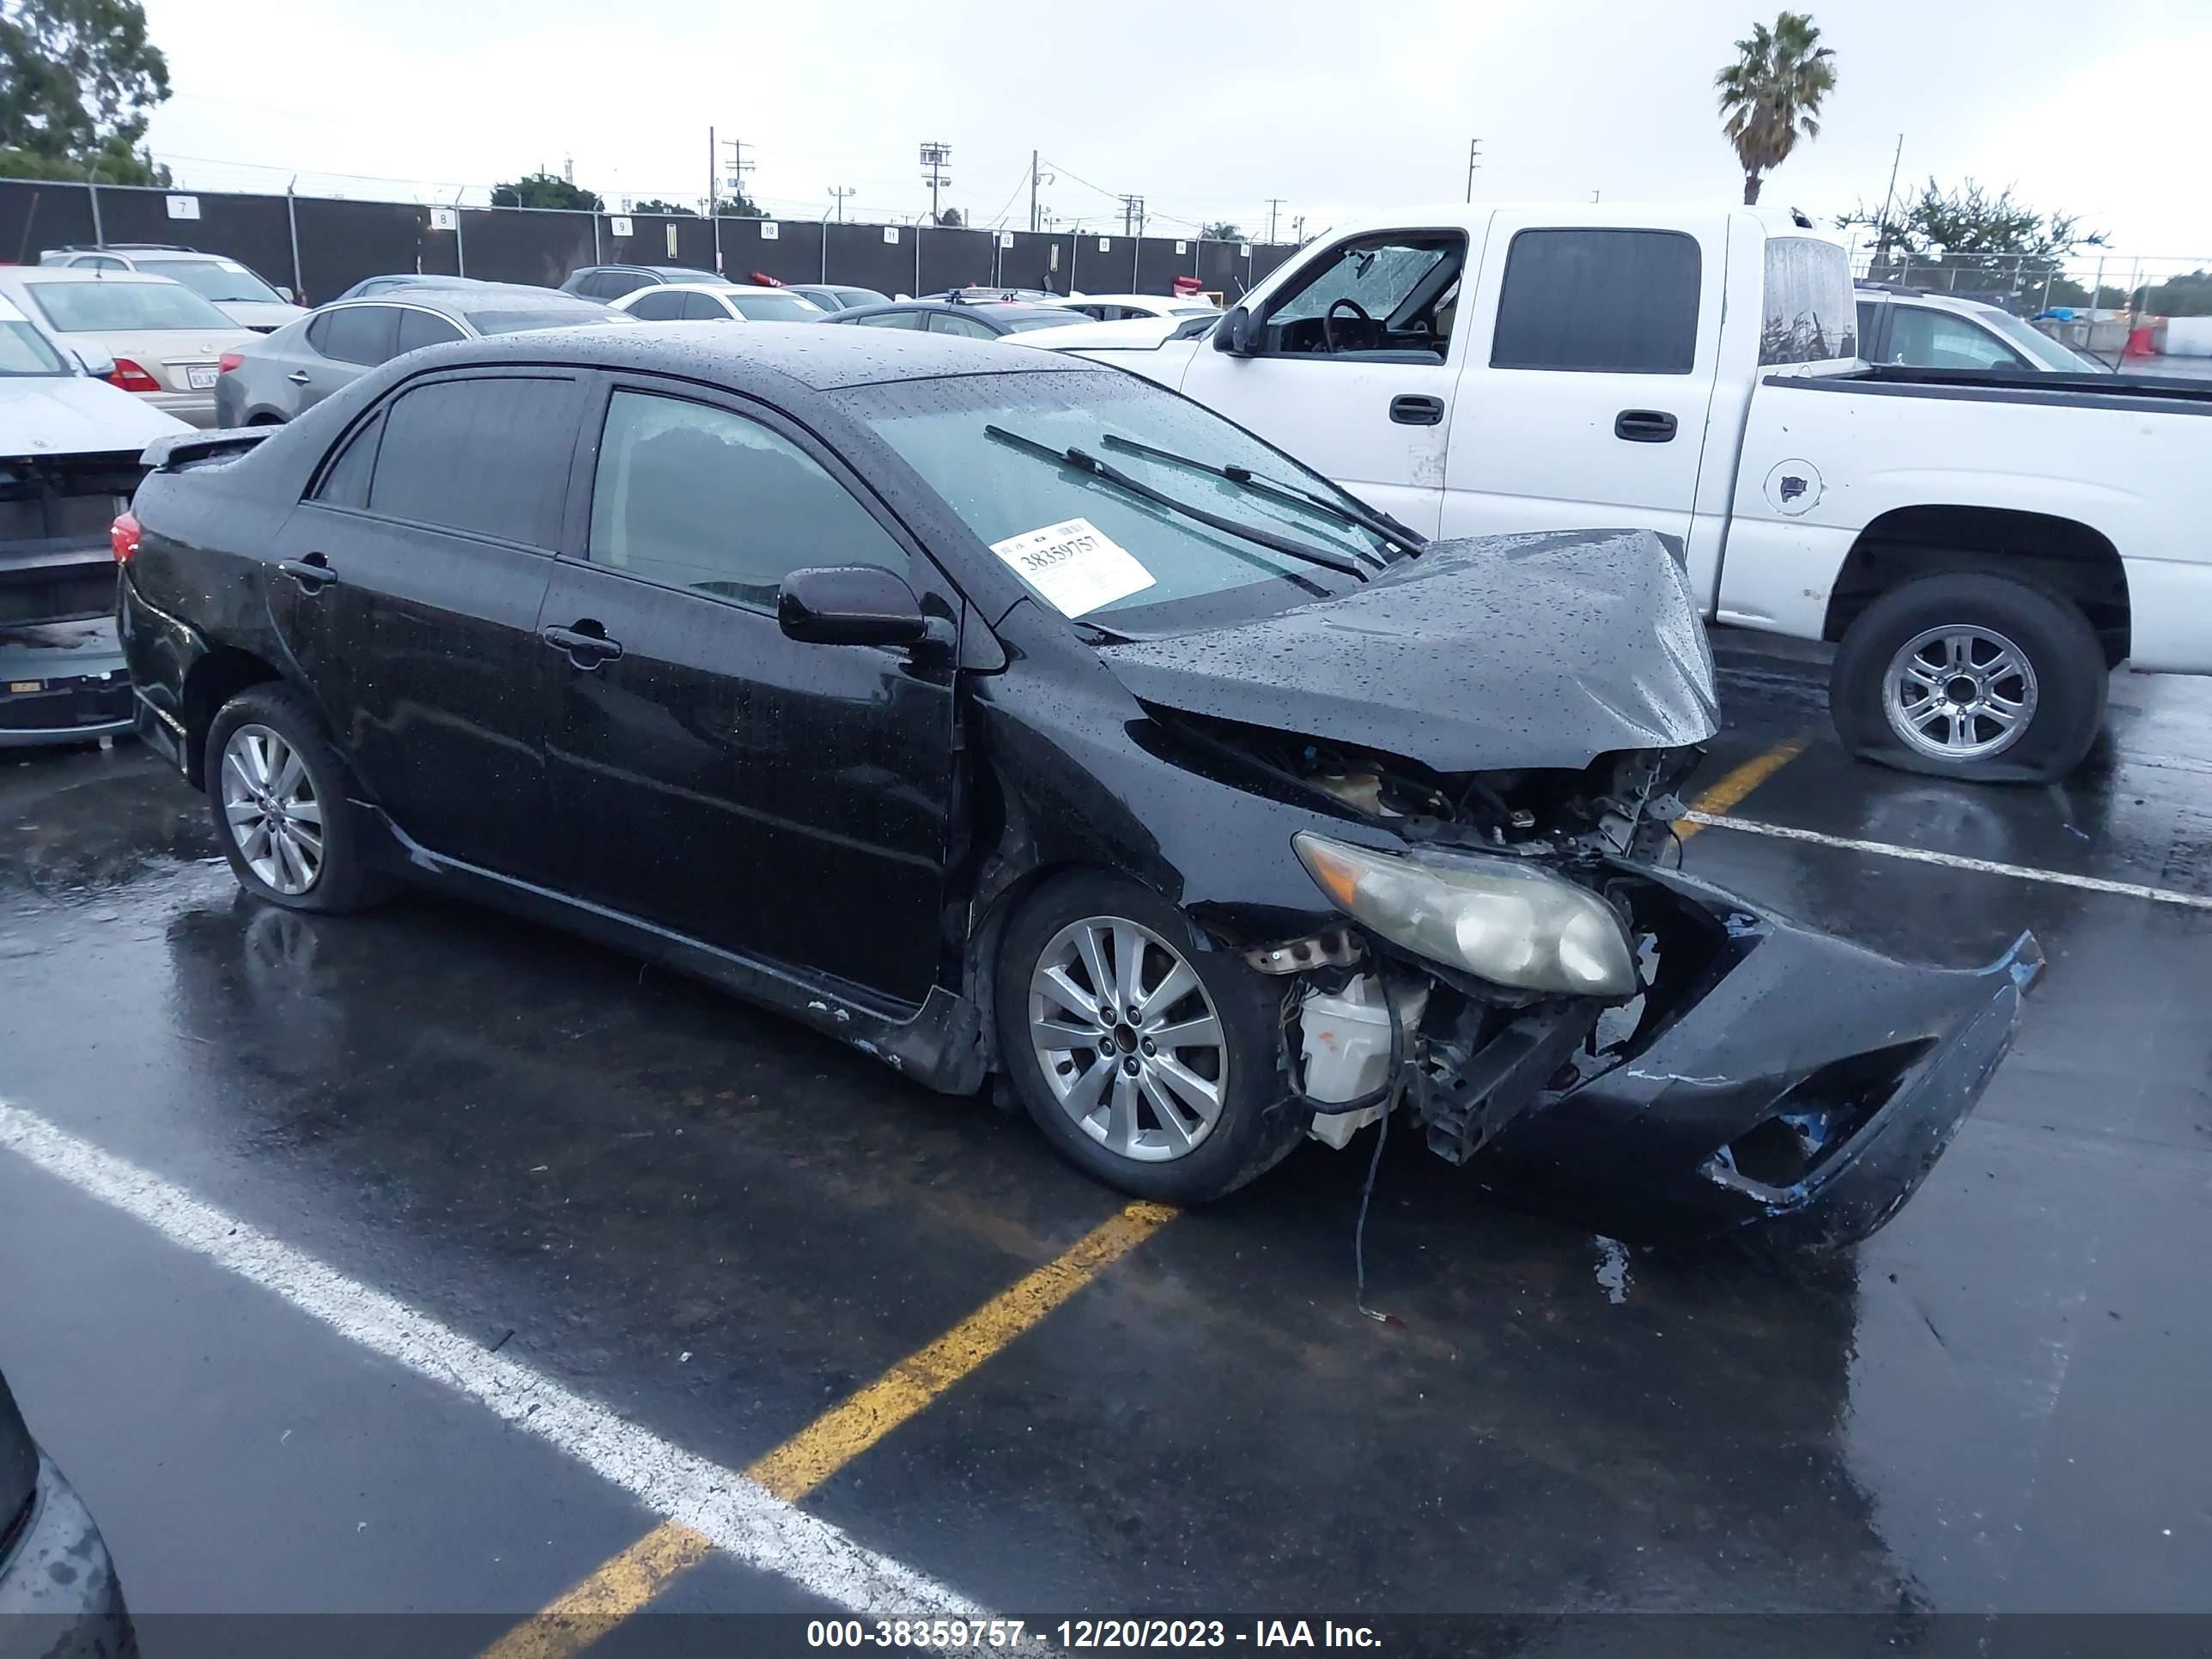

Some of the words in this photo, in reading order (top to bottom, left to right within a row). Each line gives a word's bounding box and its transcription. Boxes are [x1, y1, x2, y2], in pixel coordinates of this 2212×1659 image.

[178, 201, 186, 213] 7
[440, 214, 447, 225] 8
[618, 222, 625, 232] 9
[765, 226, 775, 235] 10
[888, 231, 896, 240] 11
[1020, 536, 1100, 571] 38359757
